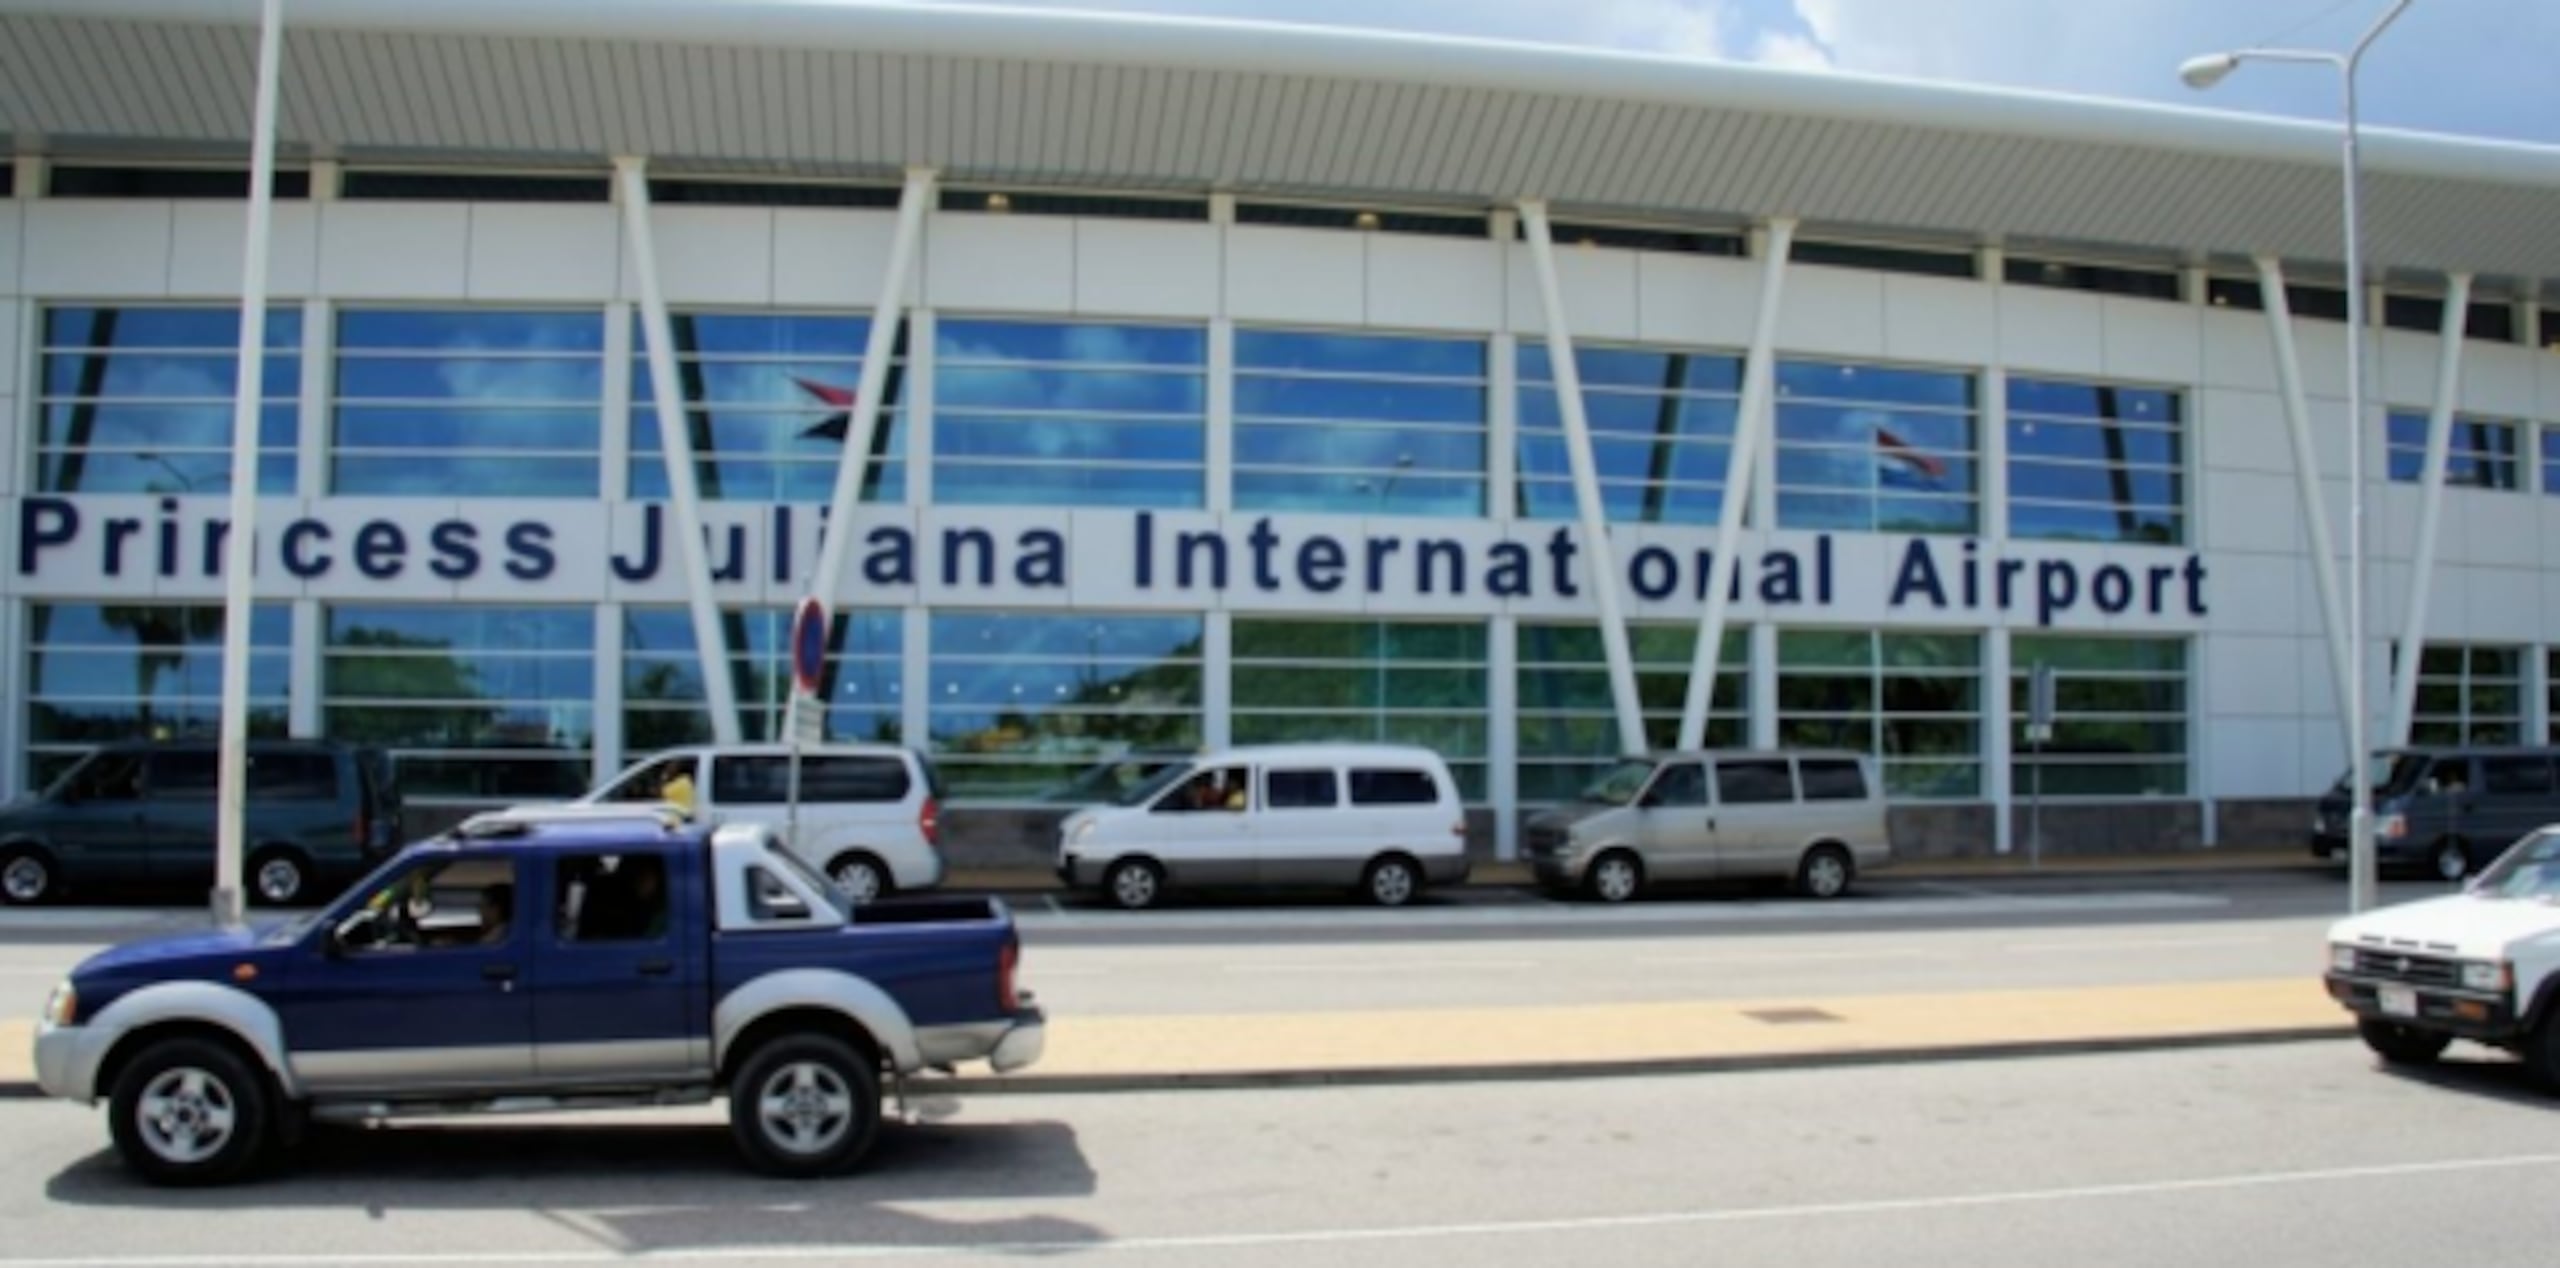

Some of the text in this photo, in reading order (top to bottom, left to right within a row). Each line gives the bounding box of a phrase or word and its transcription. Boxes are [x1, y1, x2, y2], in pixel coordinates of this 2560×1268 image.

[610, 503, 1066, 588] Julana
[1135, 510, 1833, 605] Internatonal
[1890, 537, 2208, 626] Airport
